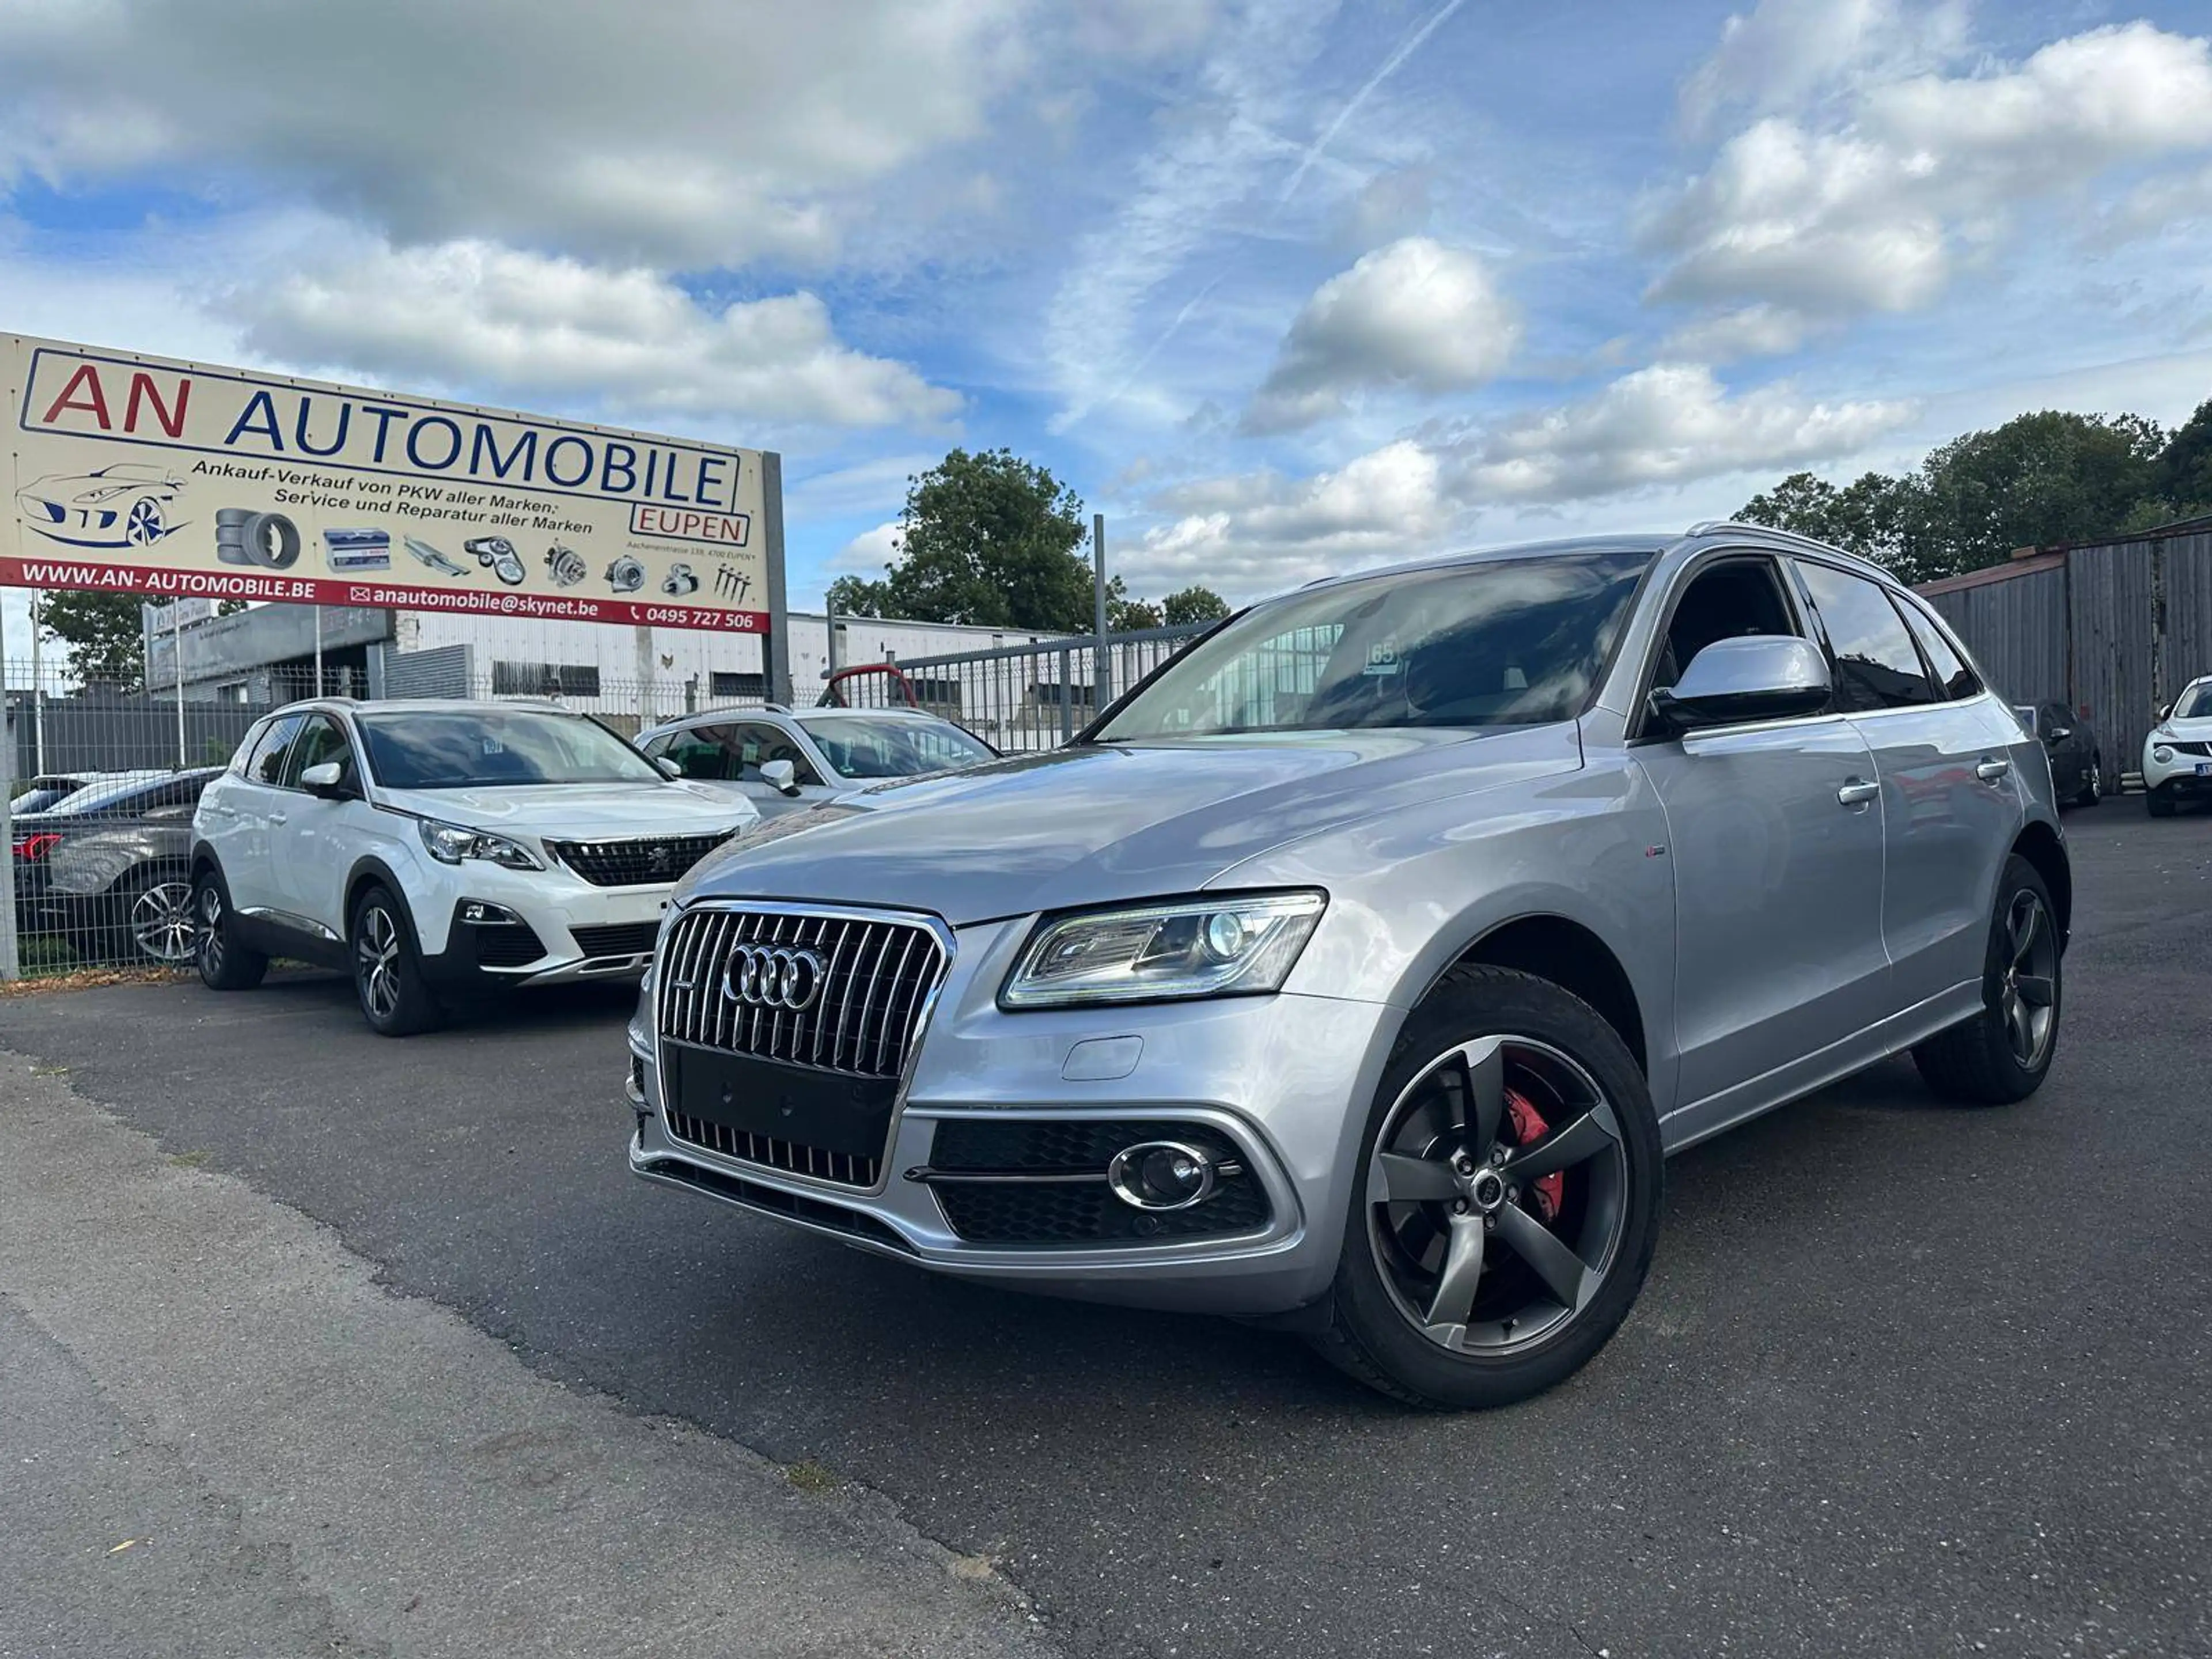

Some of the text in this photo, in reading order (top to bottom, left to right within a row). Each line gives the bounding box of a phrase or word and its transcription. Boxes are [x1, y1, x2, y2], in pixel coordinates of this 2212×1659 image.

[43, 365, 727, 506] AN AUTOMOBILE
[191, 460, 355, 490] Ankauf-Verkauf
[358, 481, 391, 494] von
[397, 484, 443, 501] PKW
[446, 491, 486, 505] aller
[274, 489, 593, 534] Service und Reparatur aller Marken
[639, 508, 741, 541] EUPEN
[374, 588, 599, 616] anautomobile@skynet.be
[647, 607, 752, 628] 0495 727 506
[1372, 643, 1393, 664] 65
